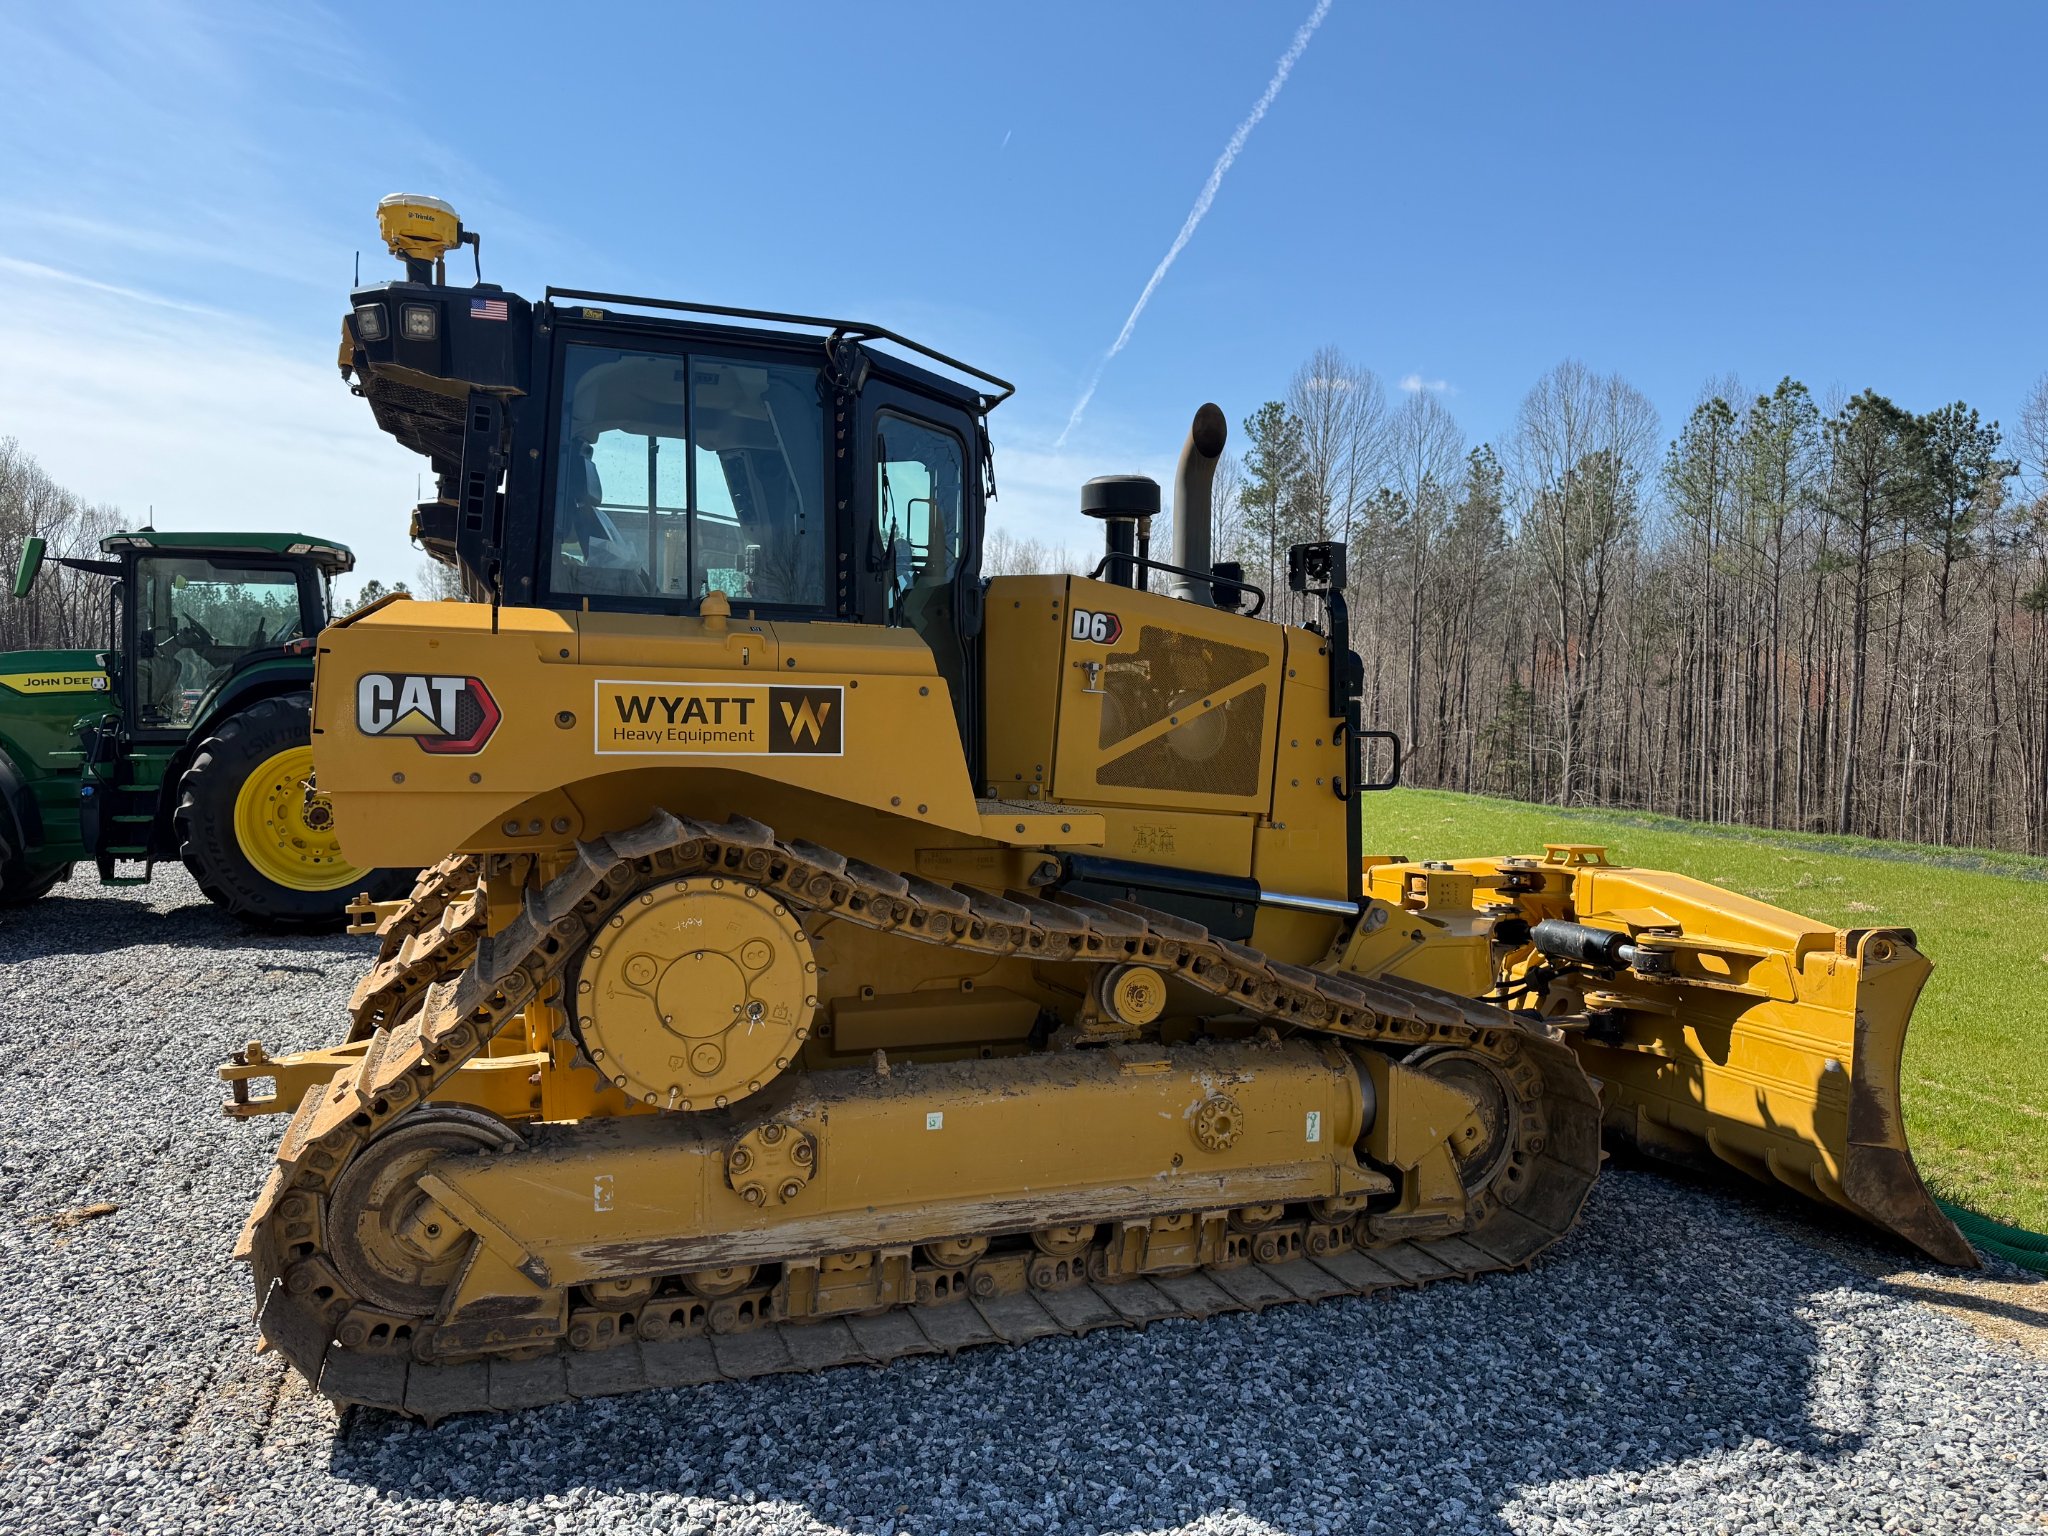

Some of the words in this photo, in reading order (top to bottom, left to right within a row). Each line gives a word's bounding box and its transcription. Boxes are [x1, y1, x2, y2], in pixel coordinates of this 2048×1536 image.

[1074, 610, 1107, 642] D6
[24, 678, 60, 687] JOHN
[63, 676, 102, 685] DEE
[358, 675, 466, 735] CAT
[614, 695, 755, 725] WYATT
[613, 727, 662, 743] Heavy
[667, 728, 755, 743] Equipment
